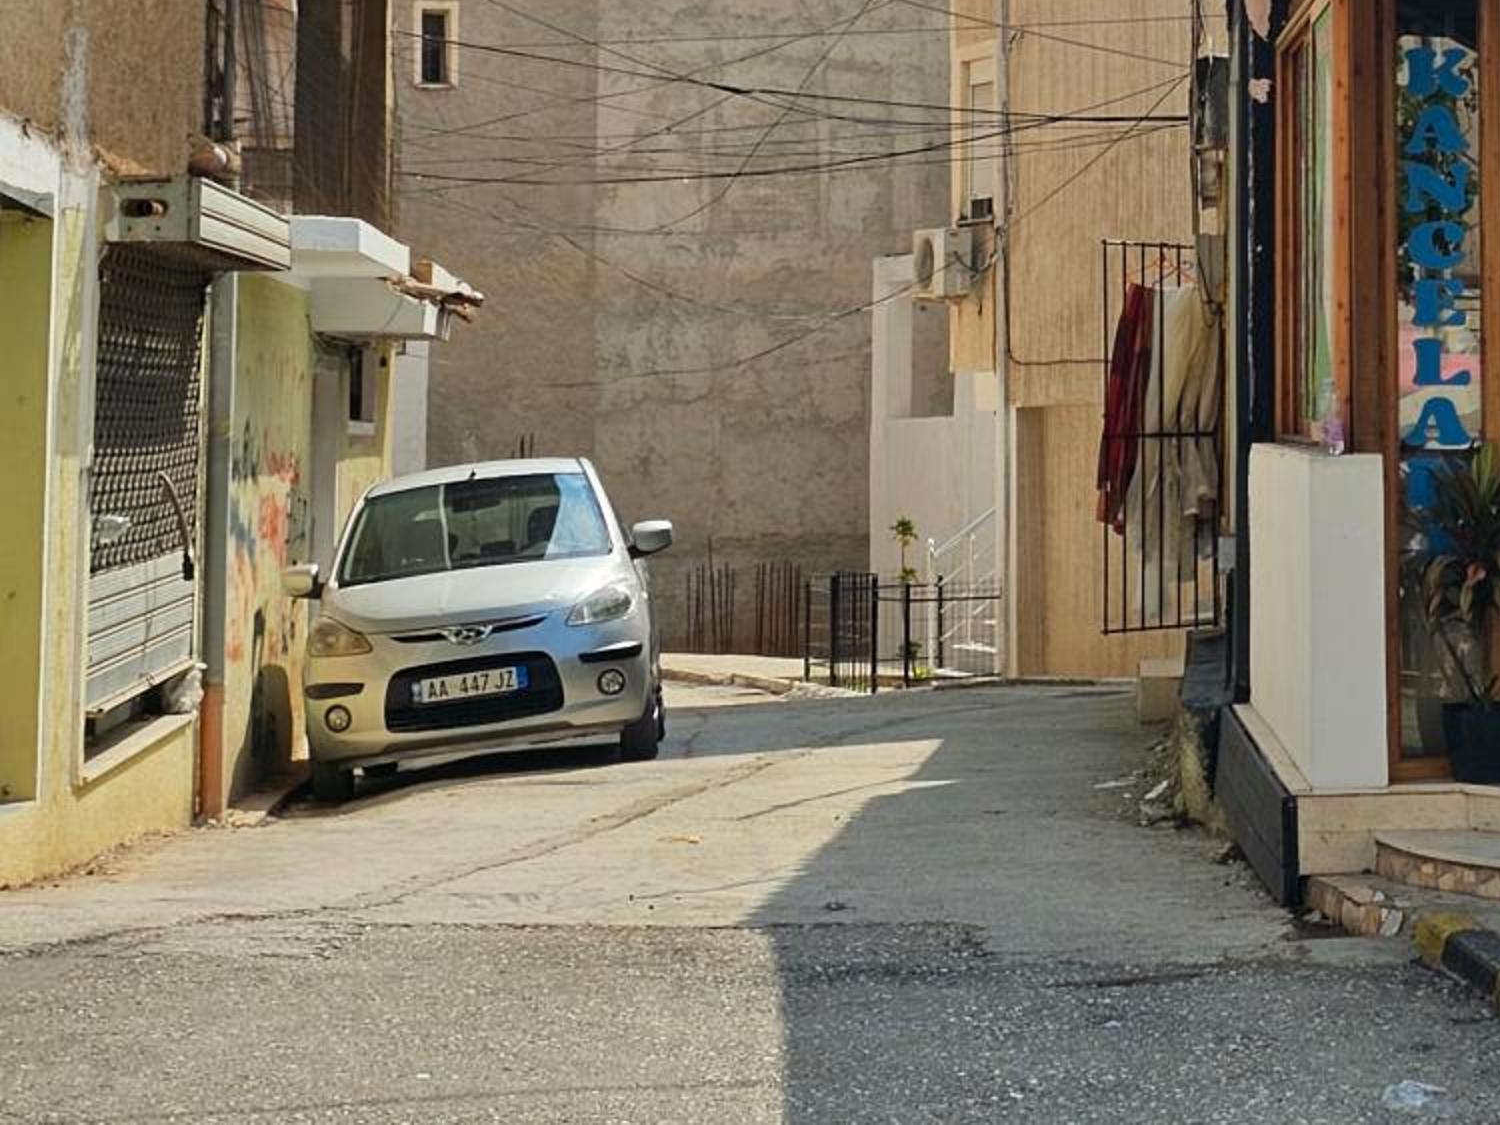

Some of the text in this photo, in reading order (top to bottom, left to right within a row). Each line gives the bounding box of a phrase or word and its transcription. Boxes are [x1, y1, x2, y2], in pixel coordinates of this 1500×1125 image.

[428, 670, 513, 700] AA 447 JZ
